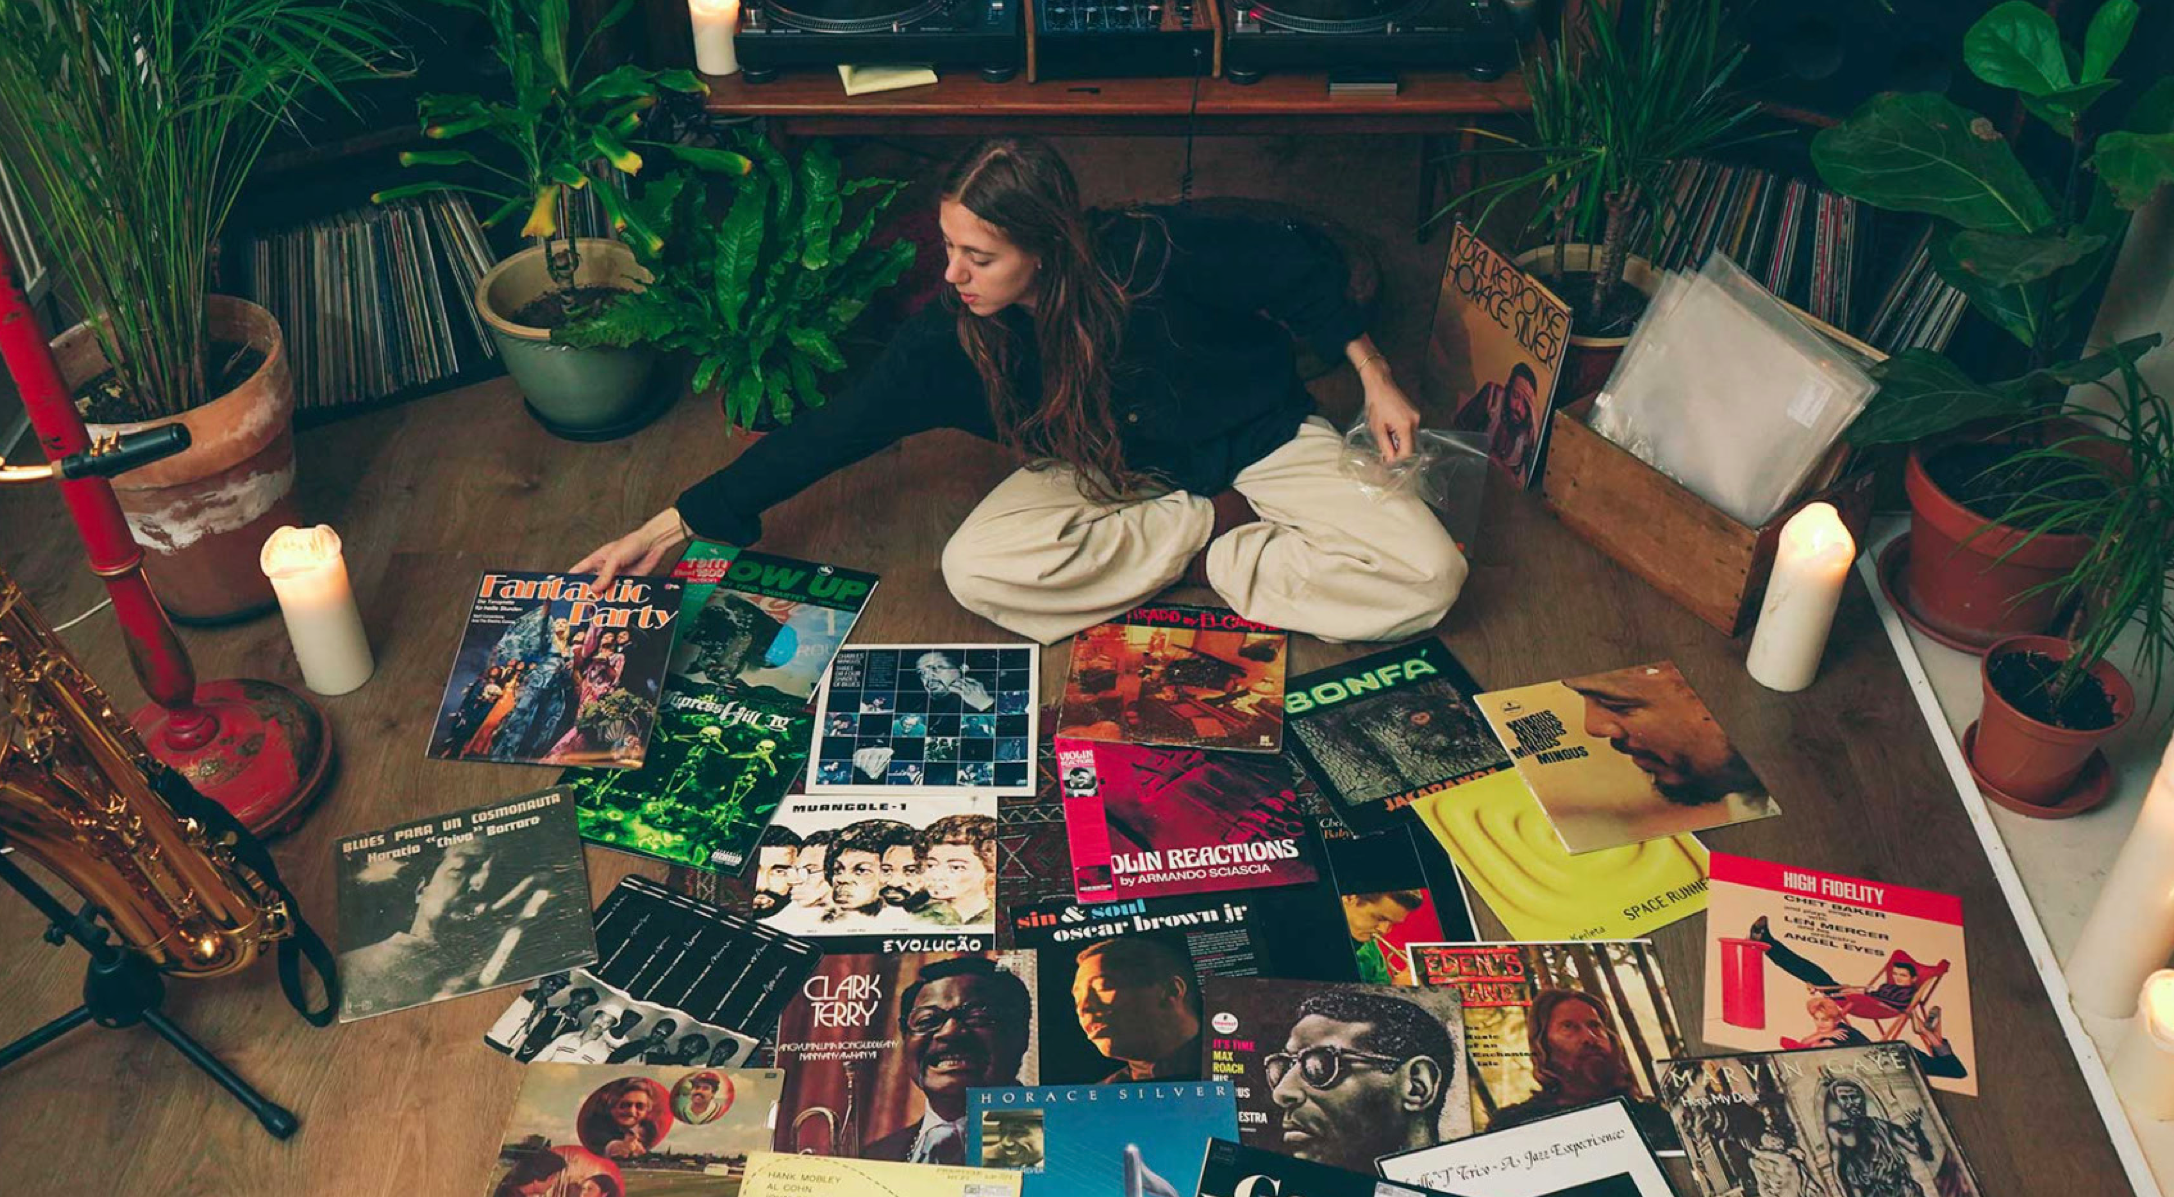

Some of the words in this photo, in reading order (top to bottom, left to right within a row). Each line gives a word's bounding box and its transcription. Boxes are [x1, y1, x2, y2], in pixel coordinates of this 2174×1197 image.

[1445, 251, 1510, 330] HORACE
[1513, 310, 1557, 371] SILVER
[1488, 257, 1567, 342] RESPONSE
[726, 559, 806, 590] OW
[806, 572, 869, 600] UP
[568, 601, 679, 630] Party
[1284, 649, 1437, 715] BONFÁ
[671, 694, 724, 716] ypress
[1536, 745, 1589, 765] MINGUS
[342, 834, 385, 854] BLUES
[394, 823, 433, 842] PARA
[442, 817, 462, 831] UN
[471, 792, 561, 825] COSMONAUTA
[367, 844, 420, 863] Horacio
[1111, 850, 1163, 874] OLIN
[1167, 838, 1299, 870] REACTIONS
[1119, 876, 1135, 887] by
[1137, 868, 1207, 885] ARMANDO
[1209, 862, 1272, 878] SCIASCIA
[1623, 895, 1669, 921] SPACE
[1665, 876, 1711, 904] RUNNE
[1783, 871, 1817, 893] HIGH
[1821, 877, 1884, 905] FIDELITY
[1017, 911, 1057, 930] sin
[1060, 905, 1087, 924] &
[1091, 898, 1147, 920] soul
[1783, 894, 1828, 908] CHET
[1831, 902, 1886, 920] BAKER
[1052, 920, 1129, 942] oscar
[1133, 906, 1220, 932] brown
[1223, 903, 1249, 923] jr
[1784, 915, 1816, 926] LEN
[1820, 922, 1889, 941] MERCER
[1783, 932, 1839, 949] ANGEL
[1843, 942, 1886, 957] EYES
[1423, 952, 1525, 978] EDEN'S
[803, 974, 882, 1001] CLARK
[1460, 983, 1516, 1002] LAND
[810, 1000, 879, 1028] TERRY
[1213, 1039, 1230, 1050] IT'S
[1233, 1039, 1255, 1051] TIME
[1213, 1051, 1233, 1061] MAX
[1212, 1063, 1244, 1074] ROACH
[1670, 1063, 1803, 1088] MARVIN
[1824, 1051, 1906, 1078] GAYE
[981, 1089, 1098, 1104] HORACE
[1119, 1085, 1226, 1100] SILVER
[1713, 1093, 1732, 1106] My
[1733, 1092, 1760, 1103] Dear
[1238, 1111, 1268, 1124] ESTRA
[1523, 1151, 1550, 1171] Jazz
[1550, 1129, 1626, 1158] Experience
[766, 1183, 779, 1191] AL
[783, 1184, 812, 1194] COHN
[768, 1171, 796, 1182] HANK
[801, 1174, 842, 1185] MOBLEY
